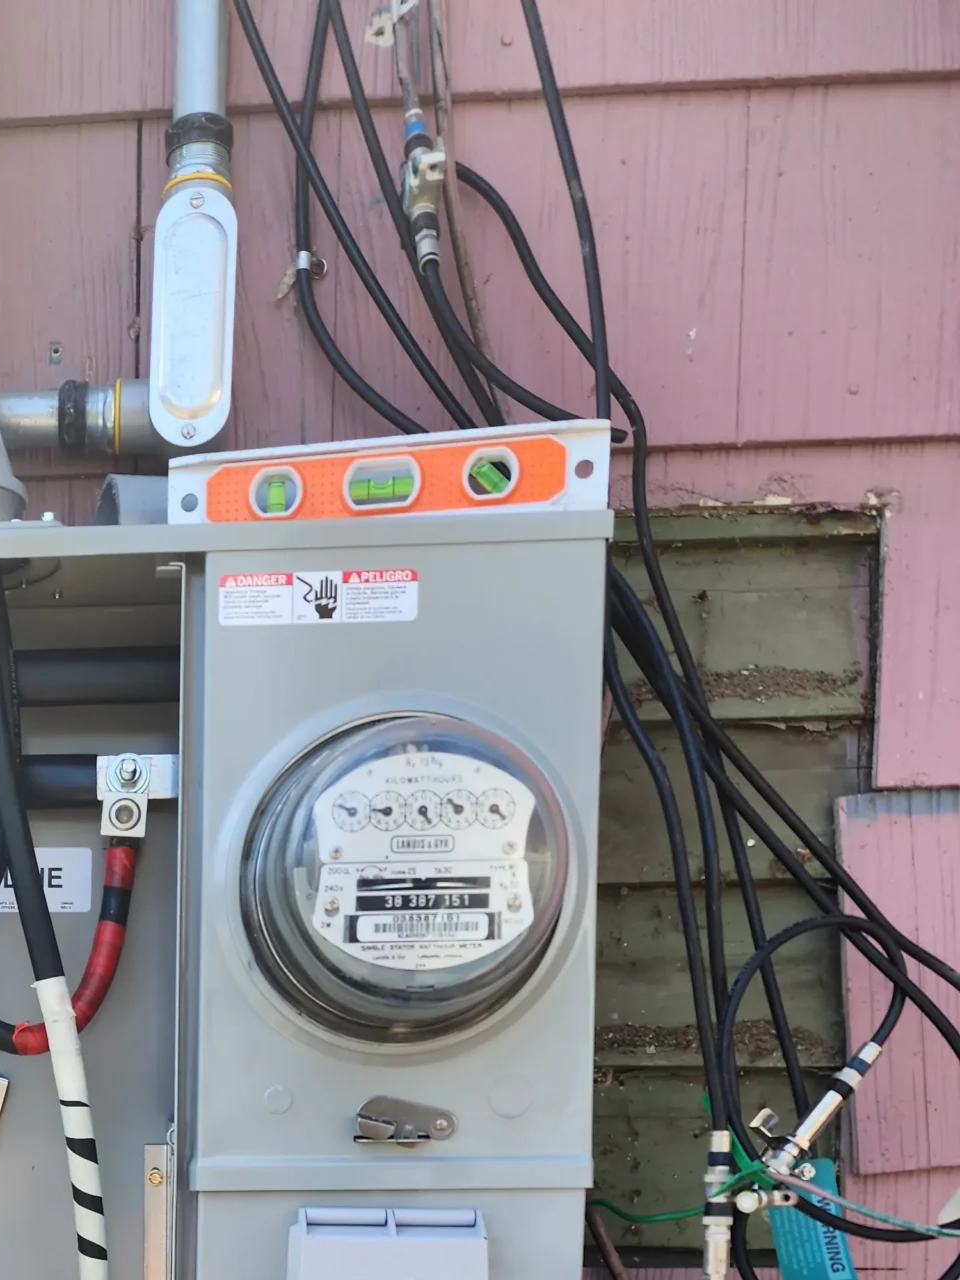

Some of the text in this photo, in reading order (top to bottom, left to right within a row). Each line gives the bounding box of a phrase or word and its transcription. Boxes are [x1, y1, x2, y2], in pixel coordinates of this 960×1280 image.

[237, 570, 412, 587] DANGER PELIGRO
[3, 867, 63, 889] LE
[384, 893, 470, 908] 38 387 151
[817, 1197, 846, 1273] WRNING
